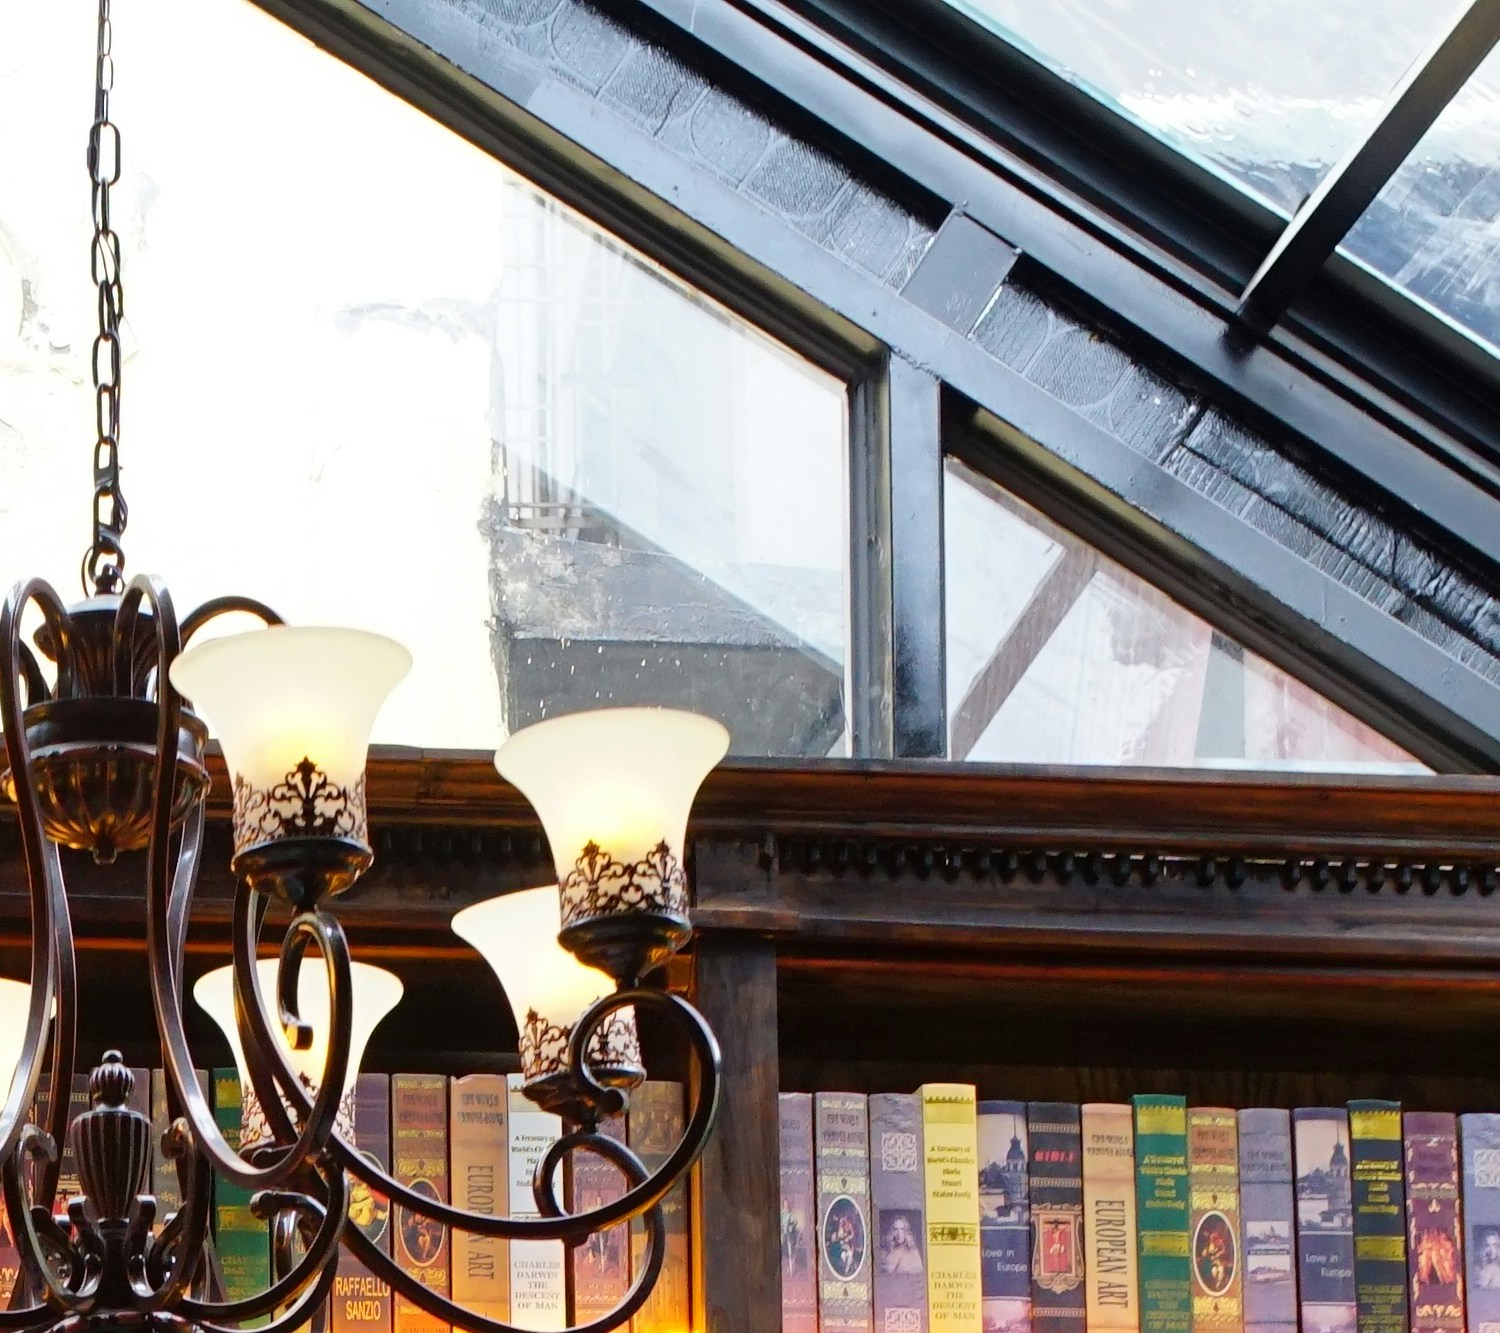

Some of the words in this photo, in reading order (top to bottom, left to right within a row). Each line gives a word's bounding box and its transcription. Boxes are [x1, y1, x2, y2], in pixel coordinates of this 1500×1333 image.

[1095, 1200, 1128, 1275] EUROPEAN
[468, 1252, 494, 1280] ART
[335, 1277, 390, 1297] RAFFAELLO
[1097, 1280, 1128, 1308] ART
[346, 1300, 381, 1320] SANZIO
